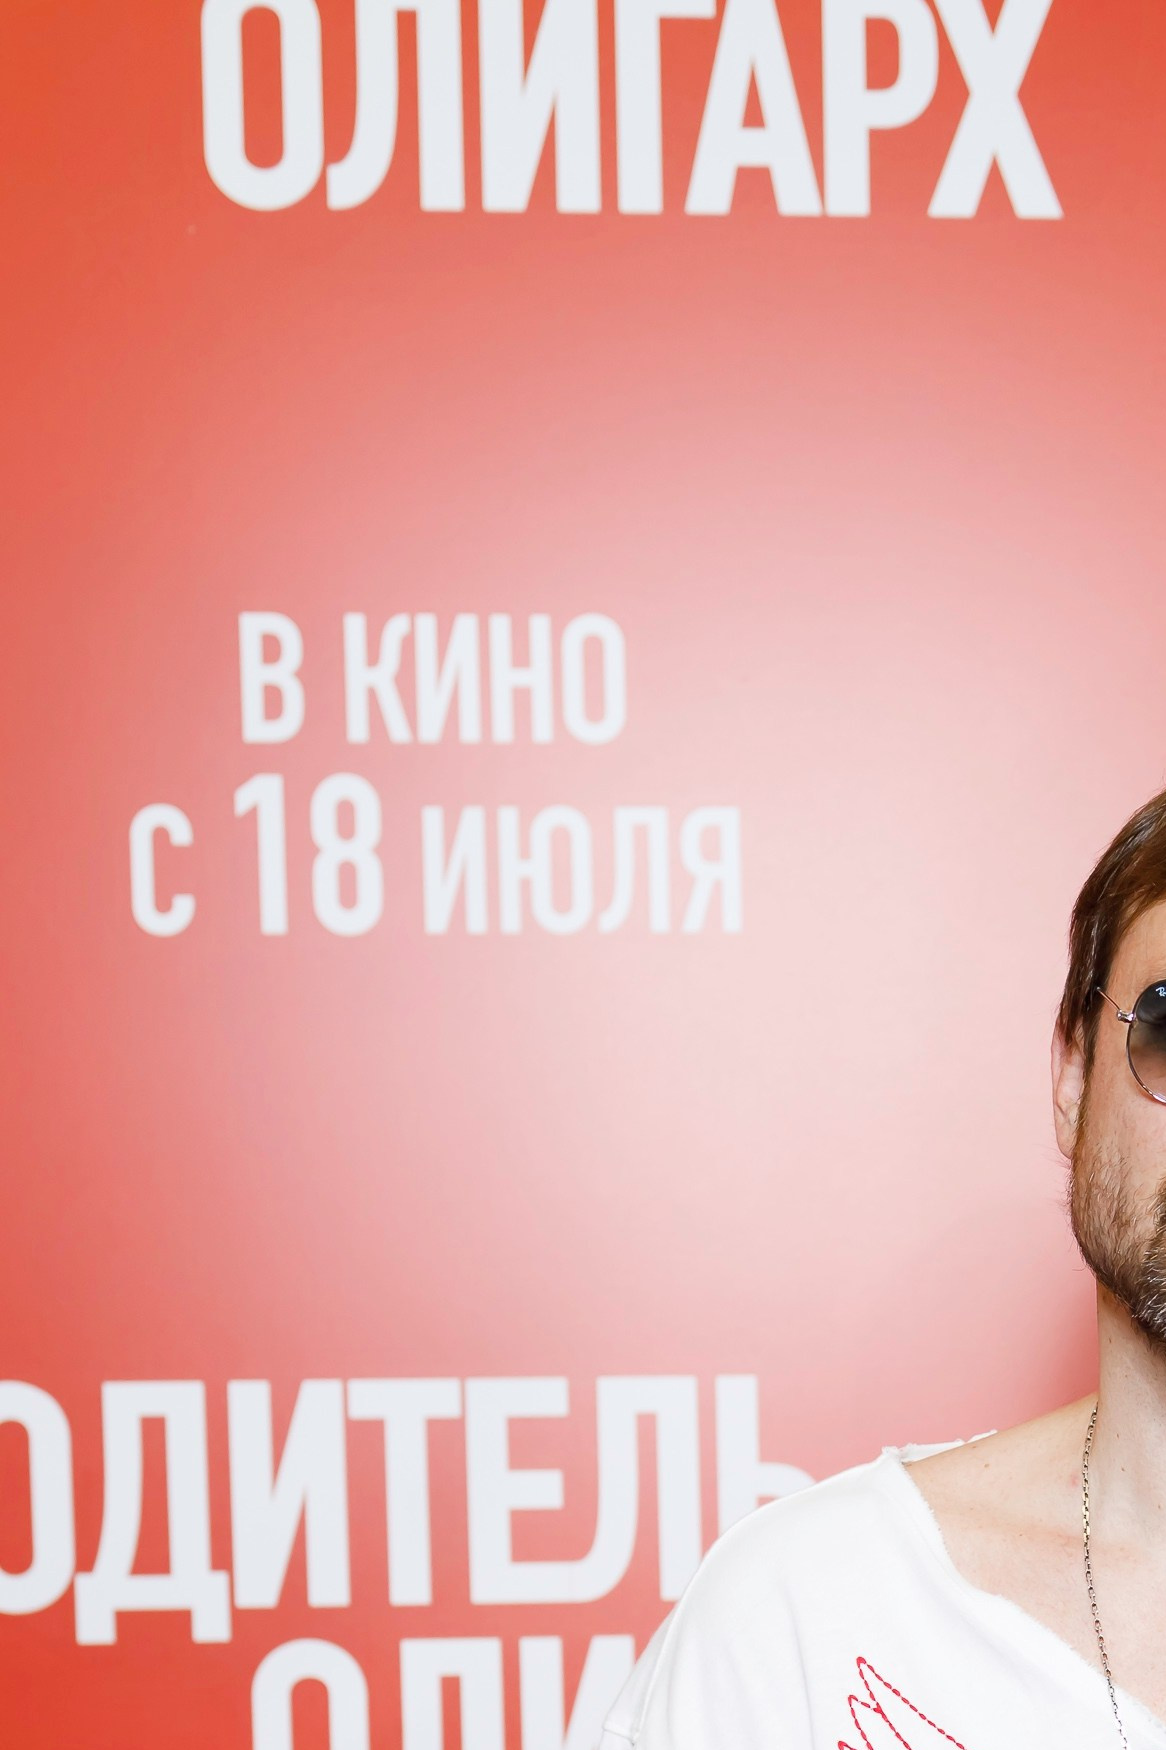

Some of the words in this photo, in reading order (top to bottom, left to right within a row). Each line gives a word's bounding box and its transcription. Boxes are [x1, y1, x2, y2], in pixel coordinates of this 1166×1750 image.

[200, 0, 1064, 220] ОЛИГАРХ
[238, 611, 306, 744] В
[342, 612, 627, 744] КИНО
[232, 772, 386, 937] 18
[420, 805, 744, 935] ИЮЛЯ
